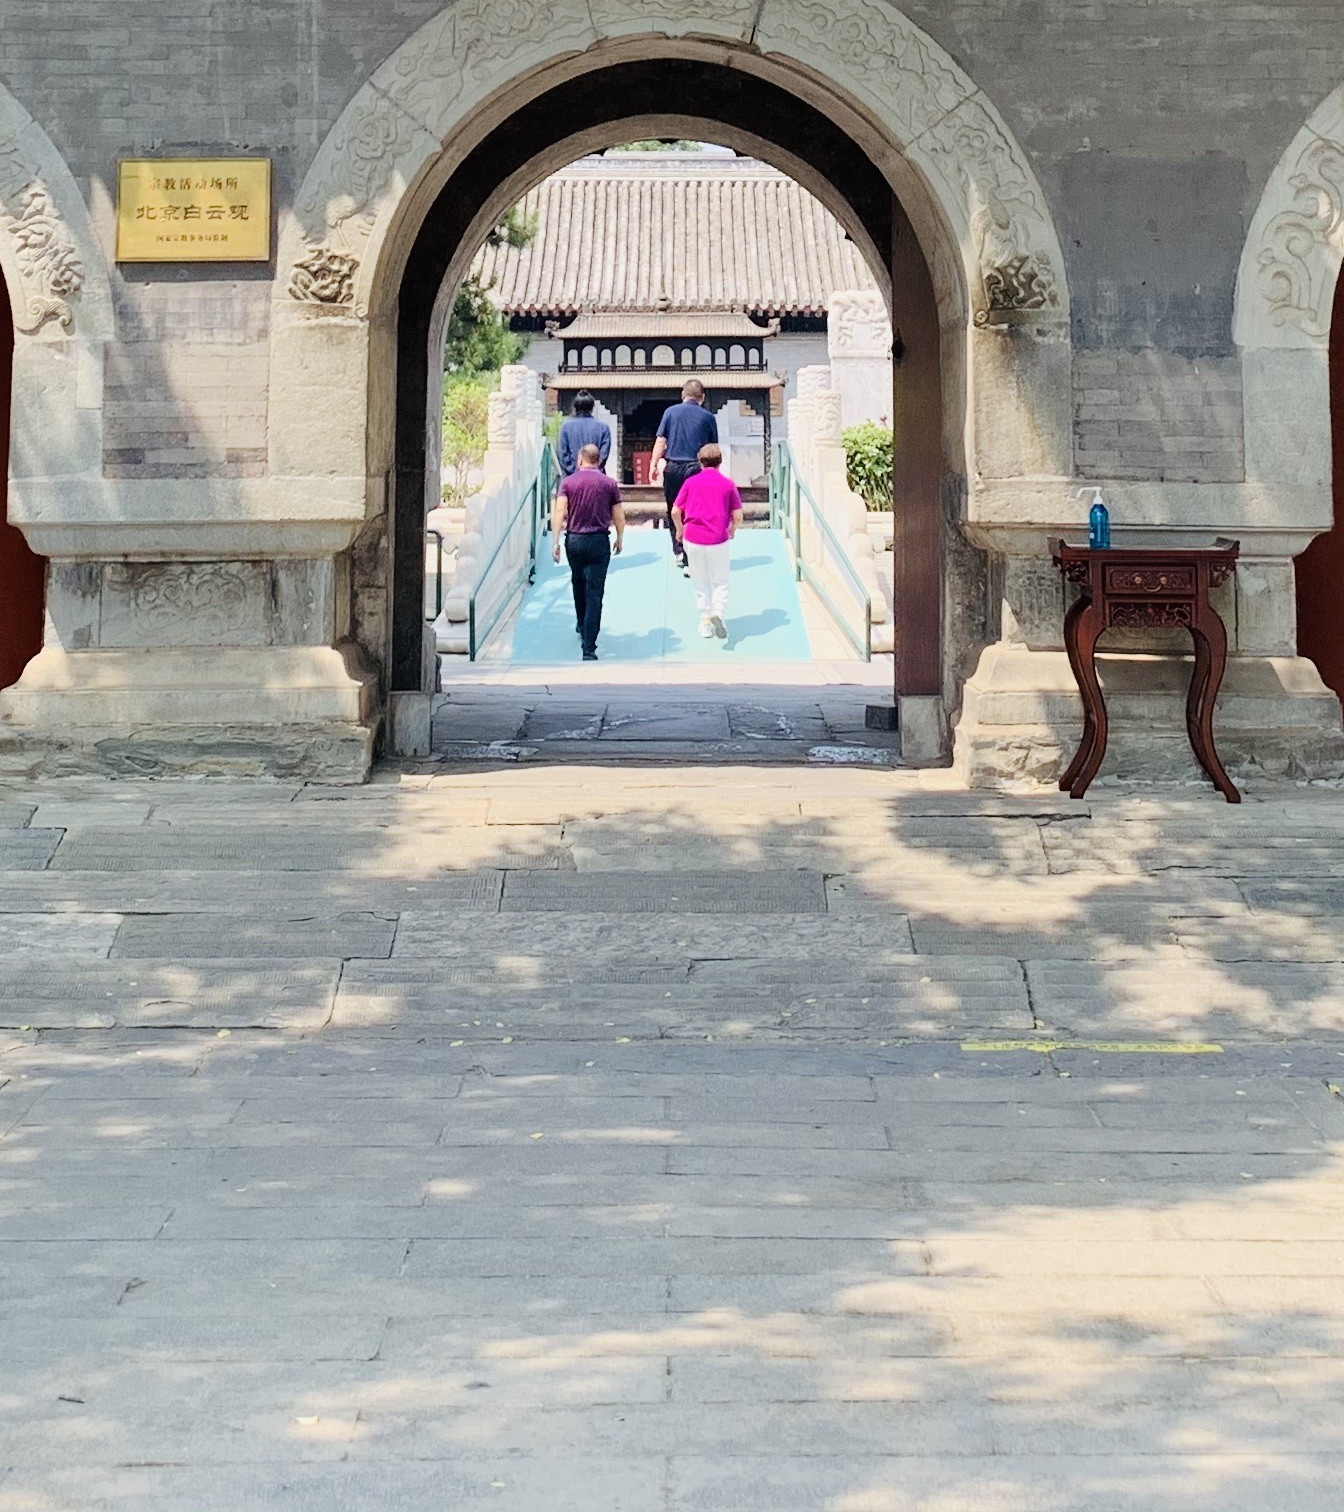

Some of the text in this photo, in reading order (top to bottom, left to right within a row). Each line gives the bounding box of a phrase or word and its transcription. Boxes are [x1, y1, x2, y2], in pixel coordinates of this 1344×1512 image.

[136, 204, 249, 221] 北京白云观
